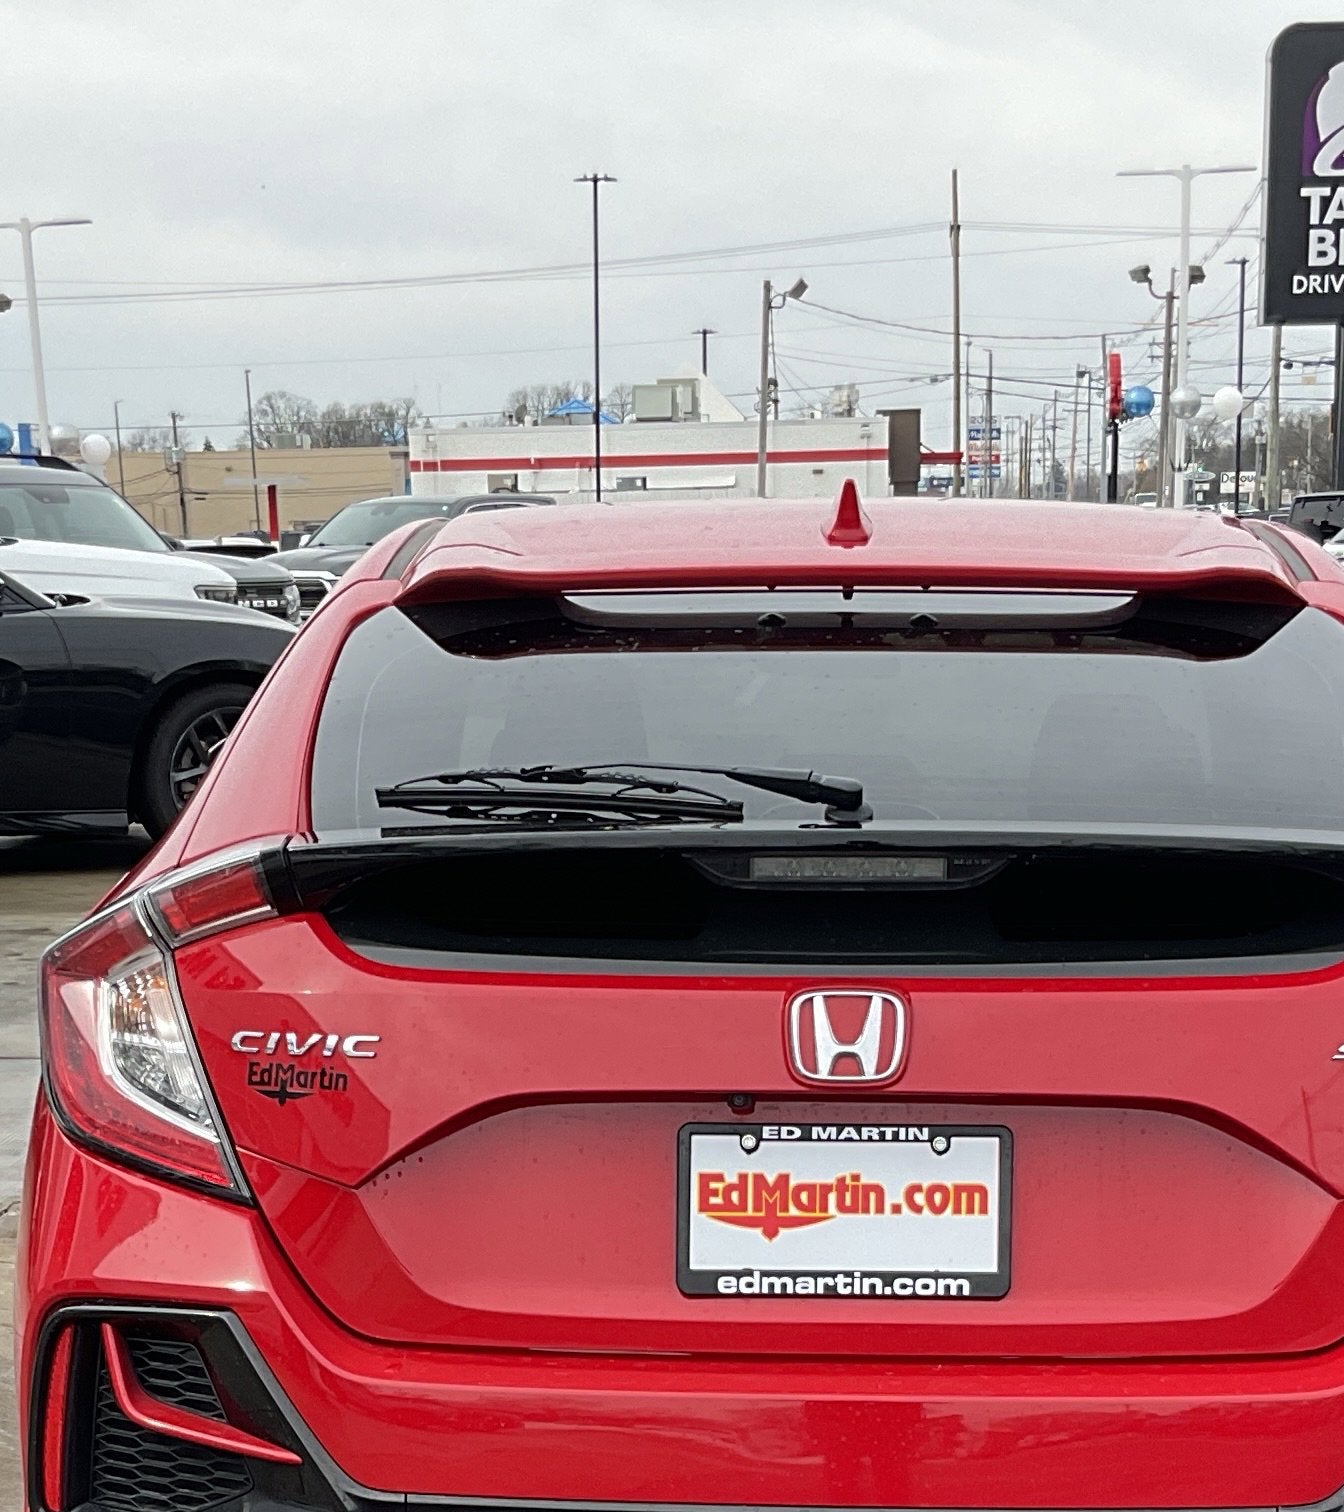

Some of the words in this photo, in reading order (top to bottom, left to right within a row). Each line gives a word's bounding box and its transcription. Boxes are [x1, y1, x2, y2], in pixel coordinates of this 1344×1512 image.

[231, 1030, 382, 1058] CIVIC
[761, 1126, 802, 1141] ED
[811, 1126, 930, 1142] MARTIN
[695, 1171, 990, 1218] EdMartin.com
[717, 1271, 970, 1296] edmartin.com
